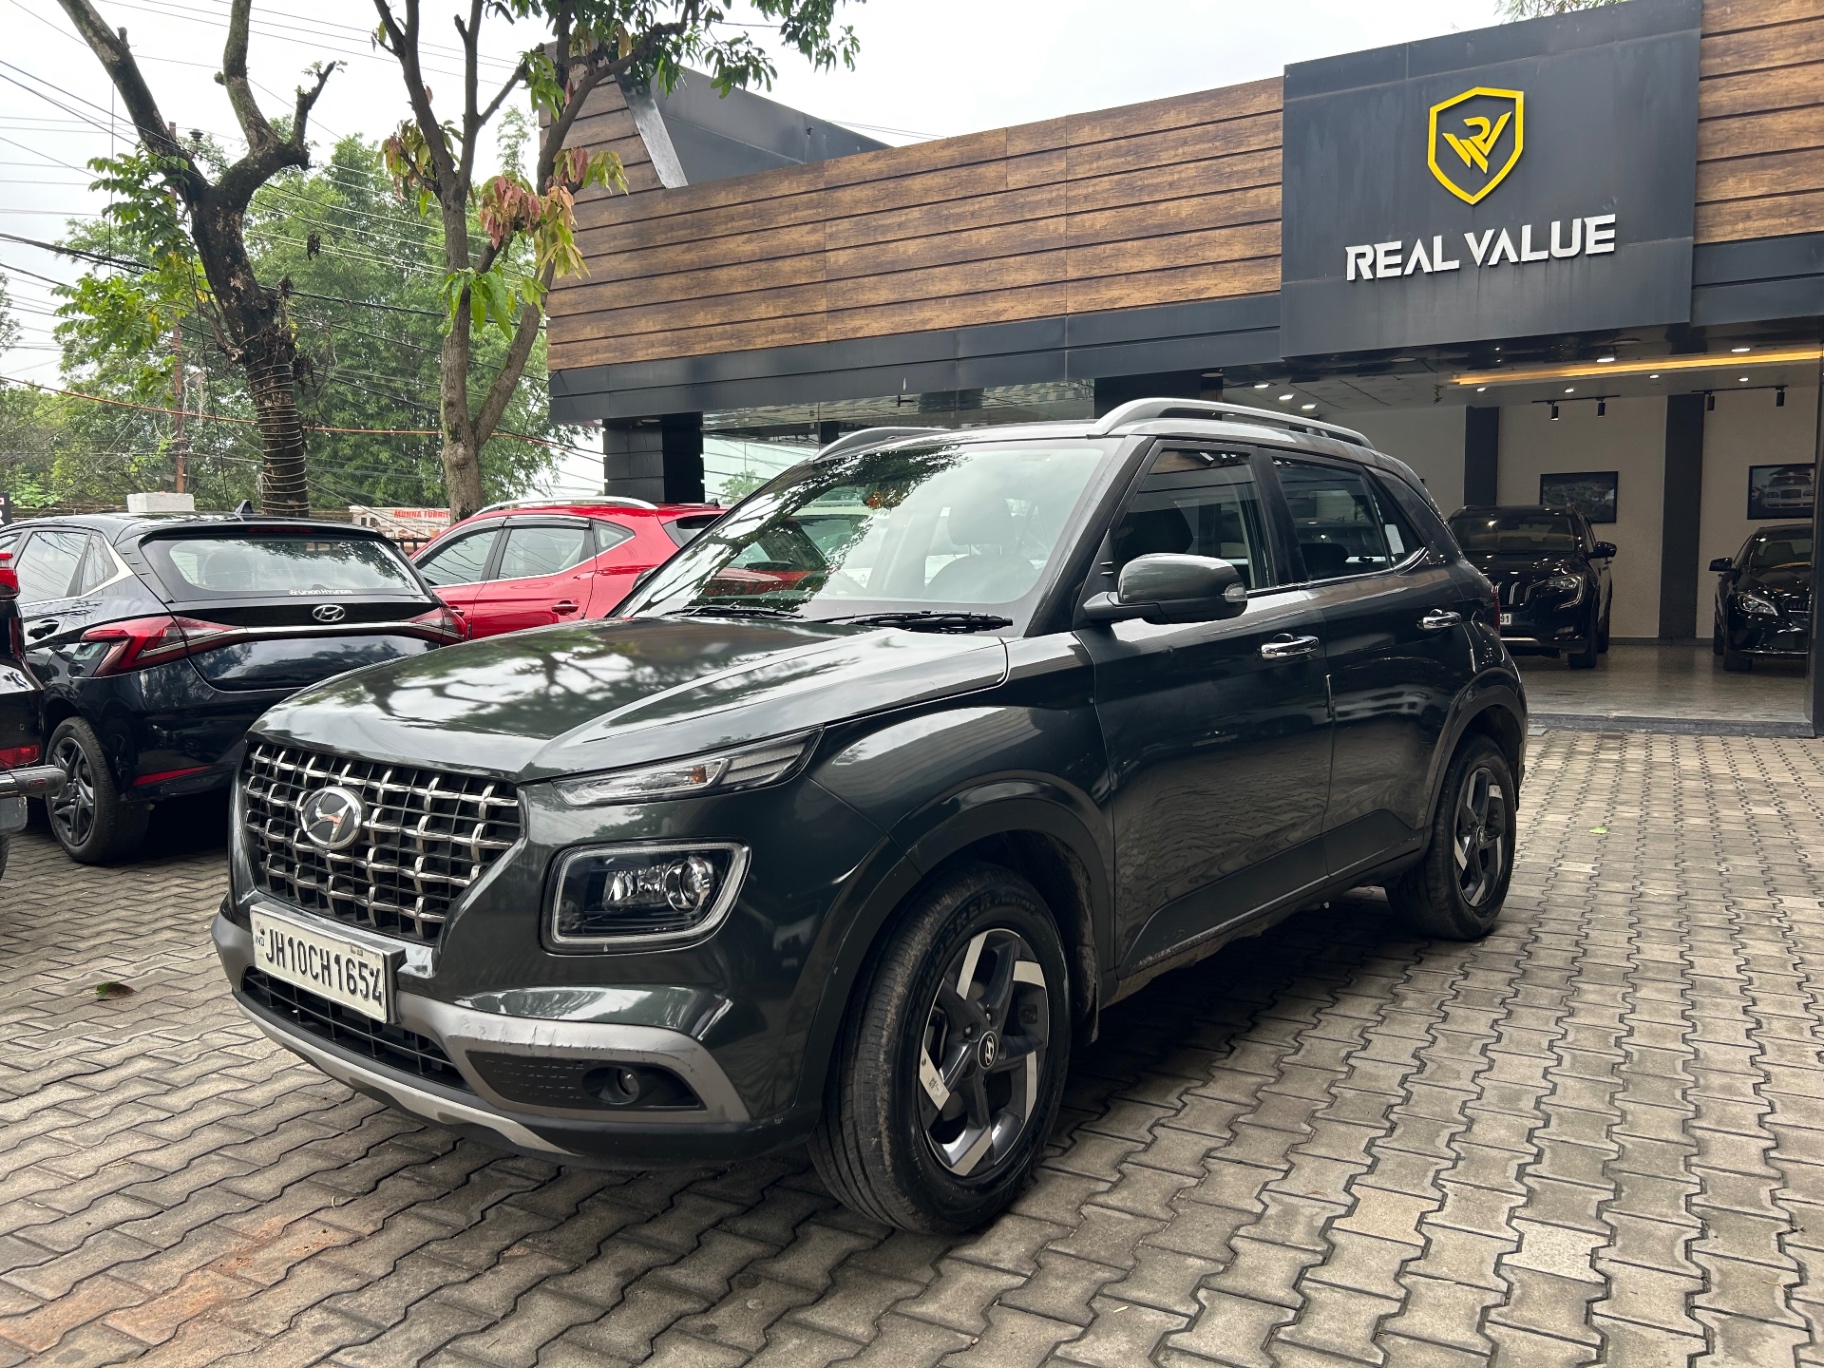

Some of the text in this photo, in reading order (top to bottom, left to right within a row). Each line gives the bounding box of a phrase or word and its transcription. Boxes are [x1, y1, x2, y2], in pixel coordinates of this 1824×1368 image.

[1345, 213, 1616, 281] REAL VALUE
[265, 928, 384, 1008] JH10CH1654
